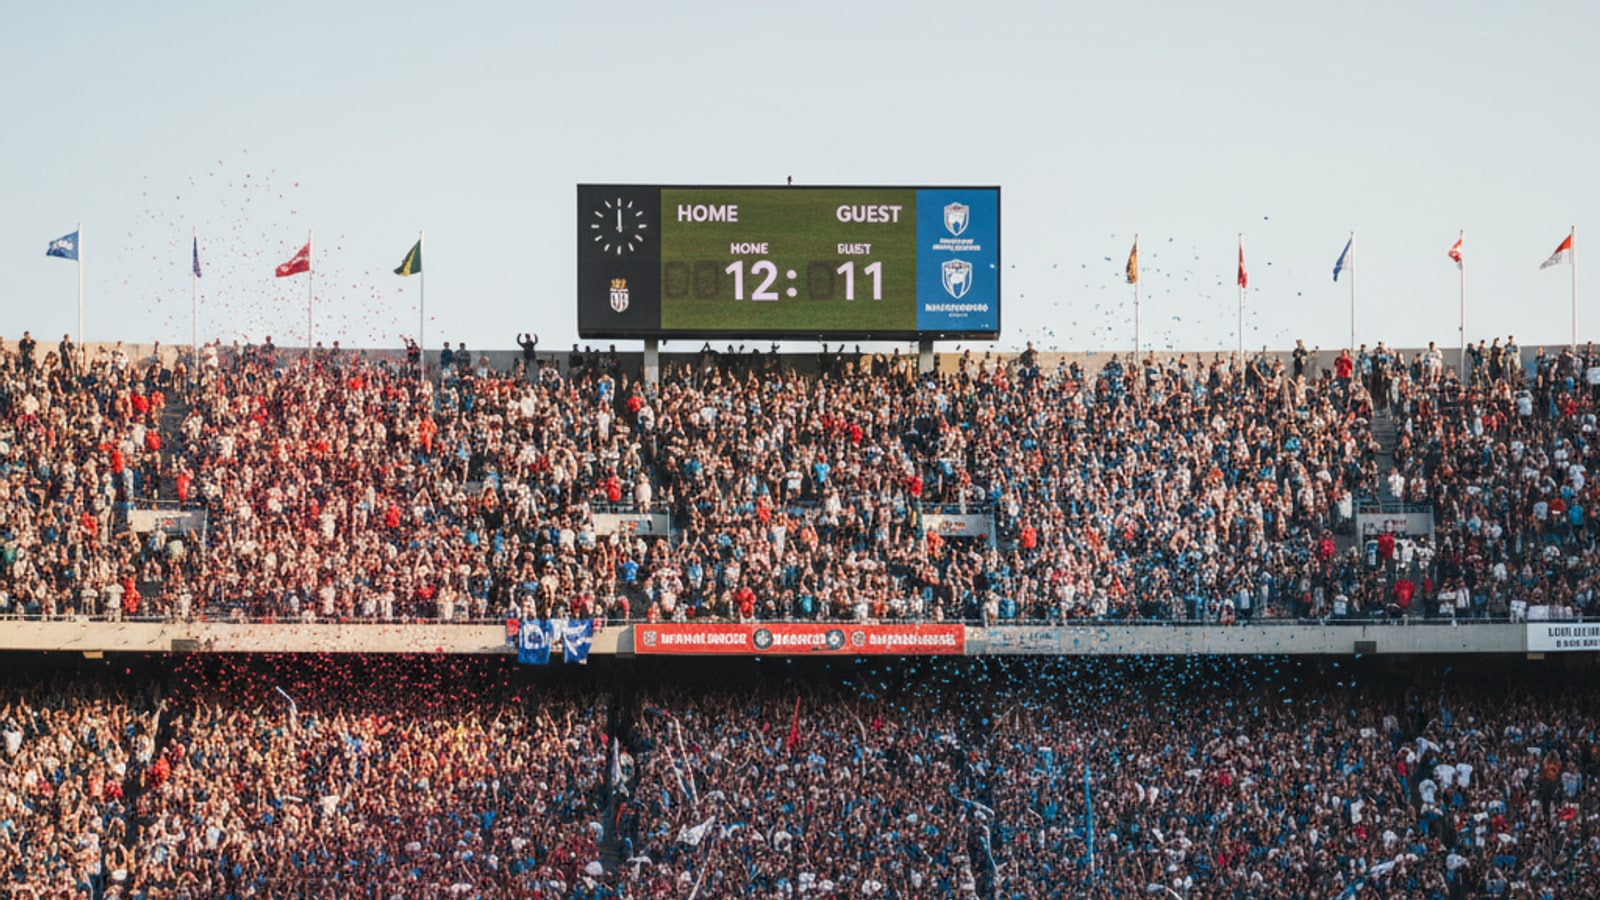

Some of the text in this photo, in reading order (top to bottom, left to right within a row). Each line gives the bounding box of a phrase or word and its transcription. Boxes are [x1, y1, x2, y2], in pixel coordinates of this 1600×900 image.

[677, 204, 902, 223] HOME GUEST
[836, 261, 882, 300] 11
